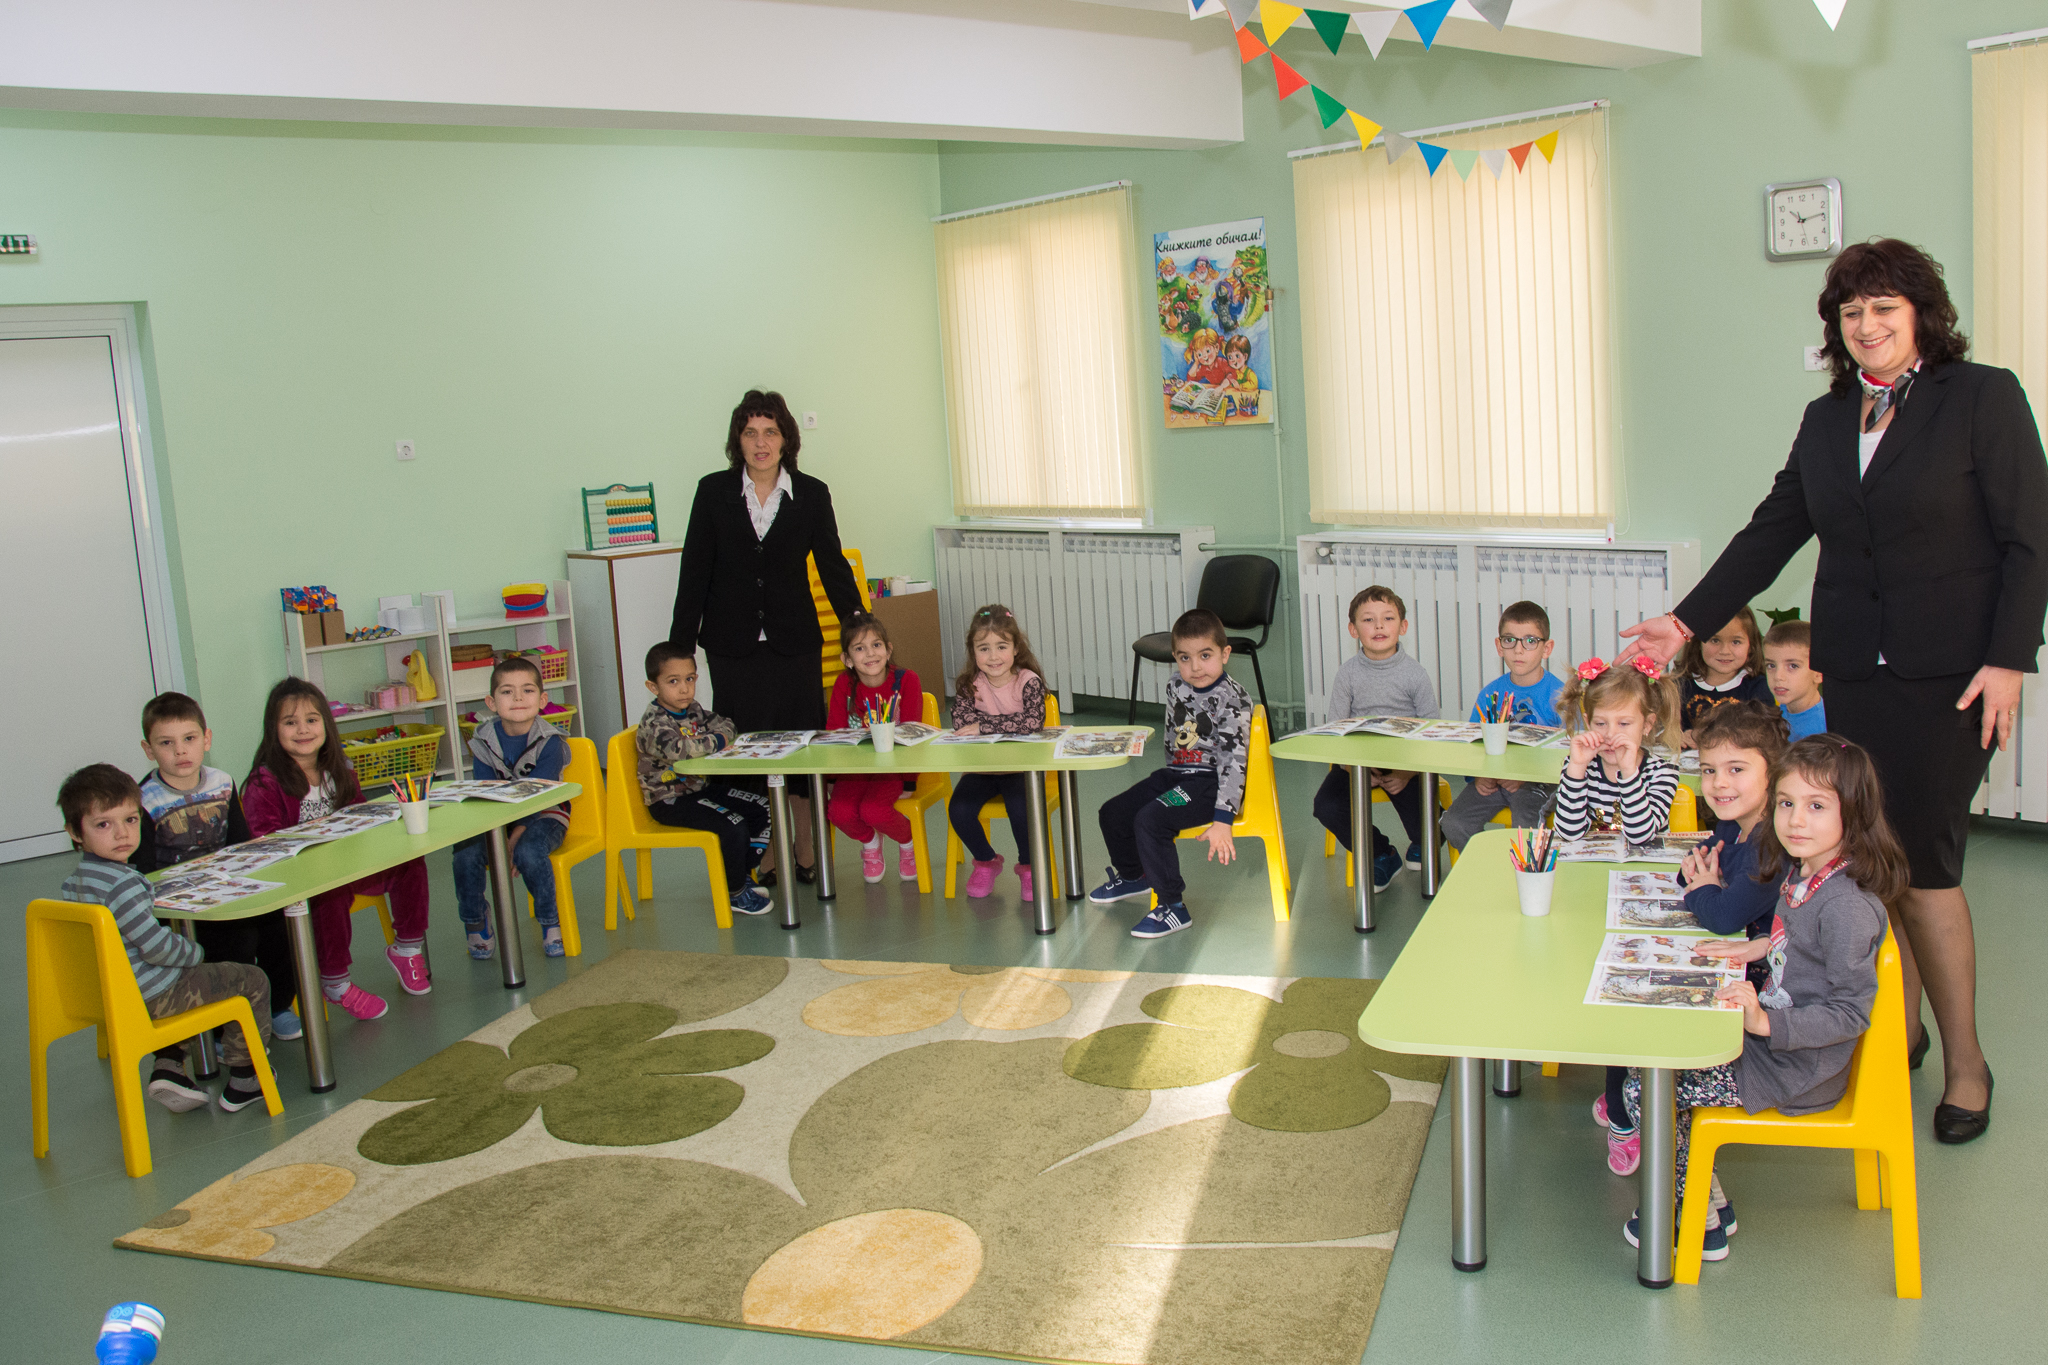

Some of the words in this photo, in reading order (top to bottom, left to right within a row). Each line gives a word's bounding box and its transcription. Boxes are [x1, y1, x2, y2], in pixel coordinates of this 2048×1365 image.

[1821, 213, 1826, 221] 3
[1155, 237, 1212, 253] Книжките
[1215, 228, 1262, 245] обичам!
[1801, 238, 1806, 246] 6
[1813, 236, 1818, 244] 5
[727, 788, 760, 803] DEEP
